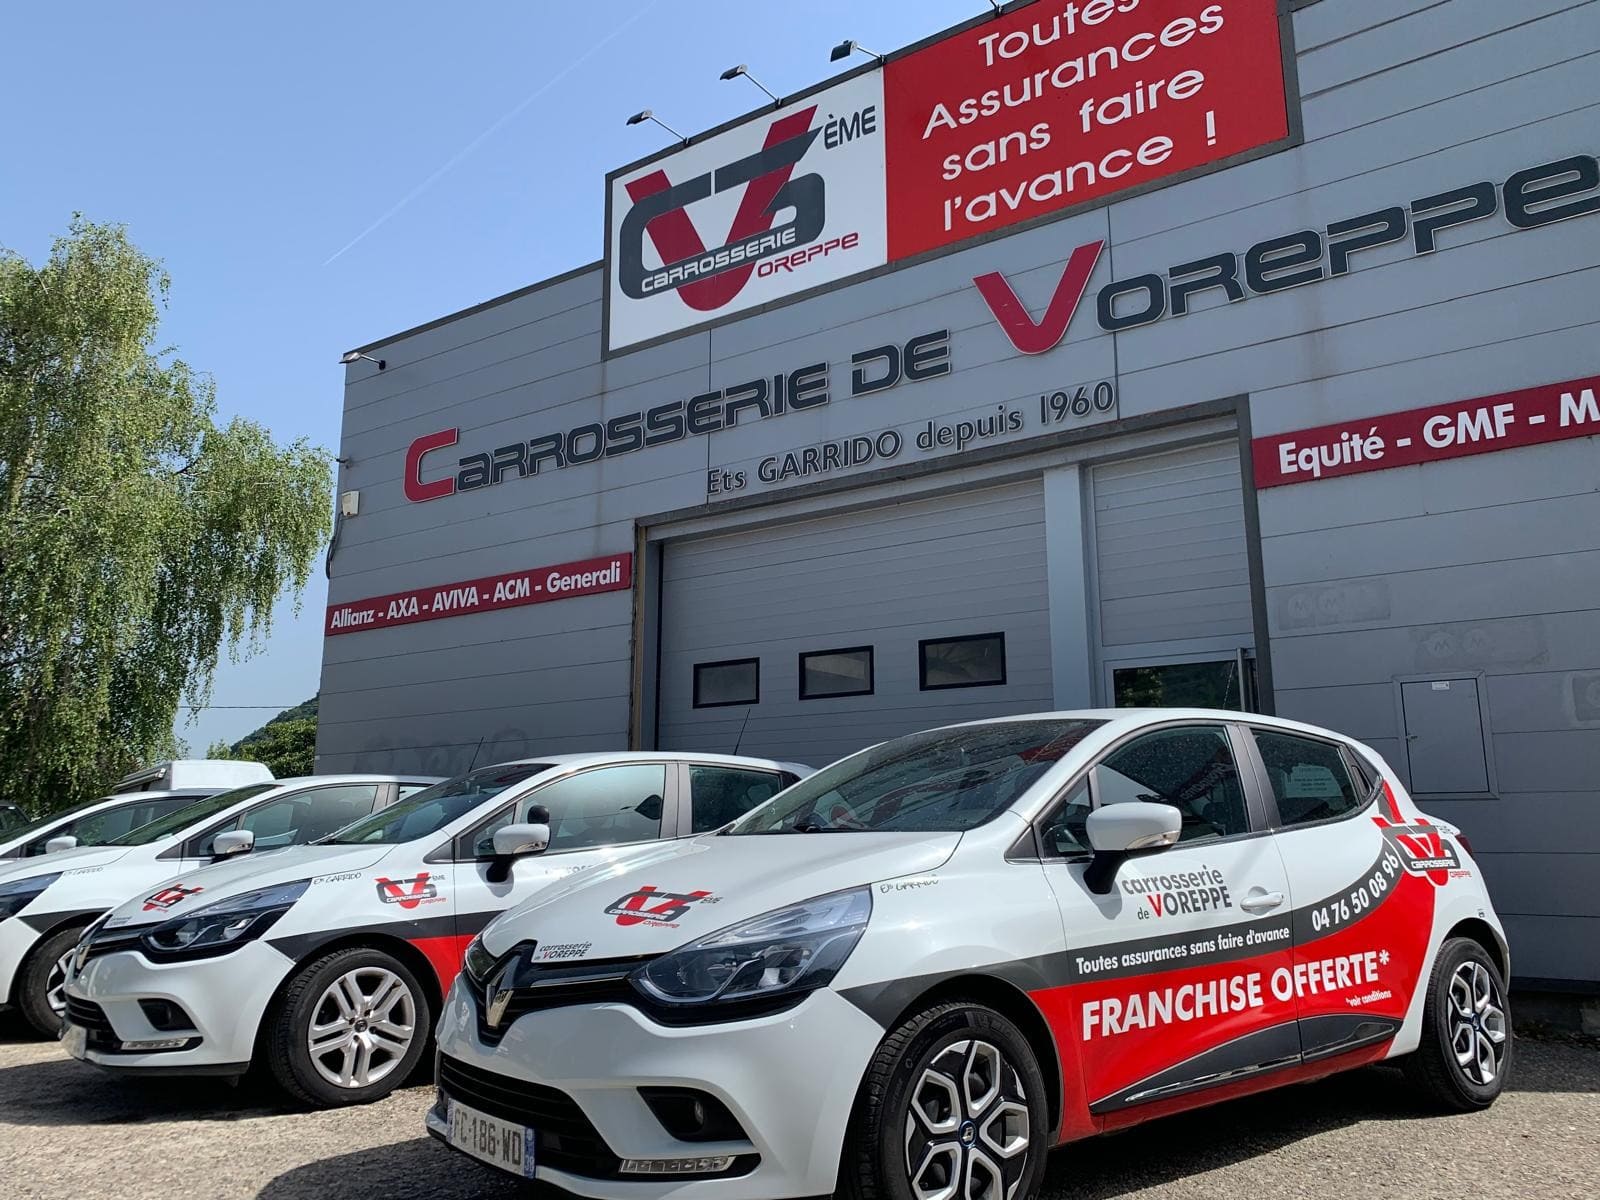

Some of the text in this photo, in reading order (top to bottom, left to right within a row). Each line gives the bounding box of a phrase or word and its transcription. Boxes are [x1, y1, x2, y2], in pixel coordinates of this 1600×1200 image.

[922, 4, 1224, 140] Assurances
[943, 68, 1205, 181] sans faire
[943, 111, 1218, 232] l'avance !
[851, 328, 952, 397] DE
[706, 381, 1115, 494] Ets GARRIDO depuis 1960
[1278, 426, 1386, 481] Equité
[1423, 402, 1515, 449] GMF
[330, 606, 375, 629] Allianz
[387, 597, 419, 620] AXA
[431, 586, 479, 613] AVIVA
[493, 577, 530, 603] ACM
[546, 562, 620, 593] Generali
[1121, 865, 1224, 896] carrosserie
[1137, 885, 1233, 921] de VOREPPE
[1311, 850, 1399, 932] 04 76 50 08 96
[540, 940, 593, 952] carrosserie
[543, 948, 588, 960] VOREPPE
[1075, 926, 1290, 975] Toutes assurances sans faire d'avance
[1081, 967, 1265, 1042] FRANCHISE
[453, 1107, 522, 1166] FC-186-WD
